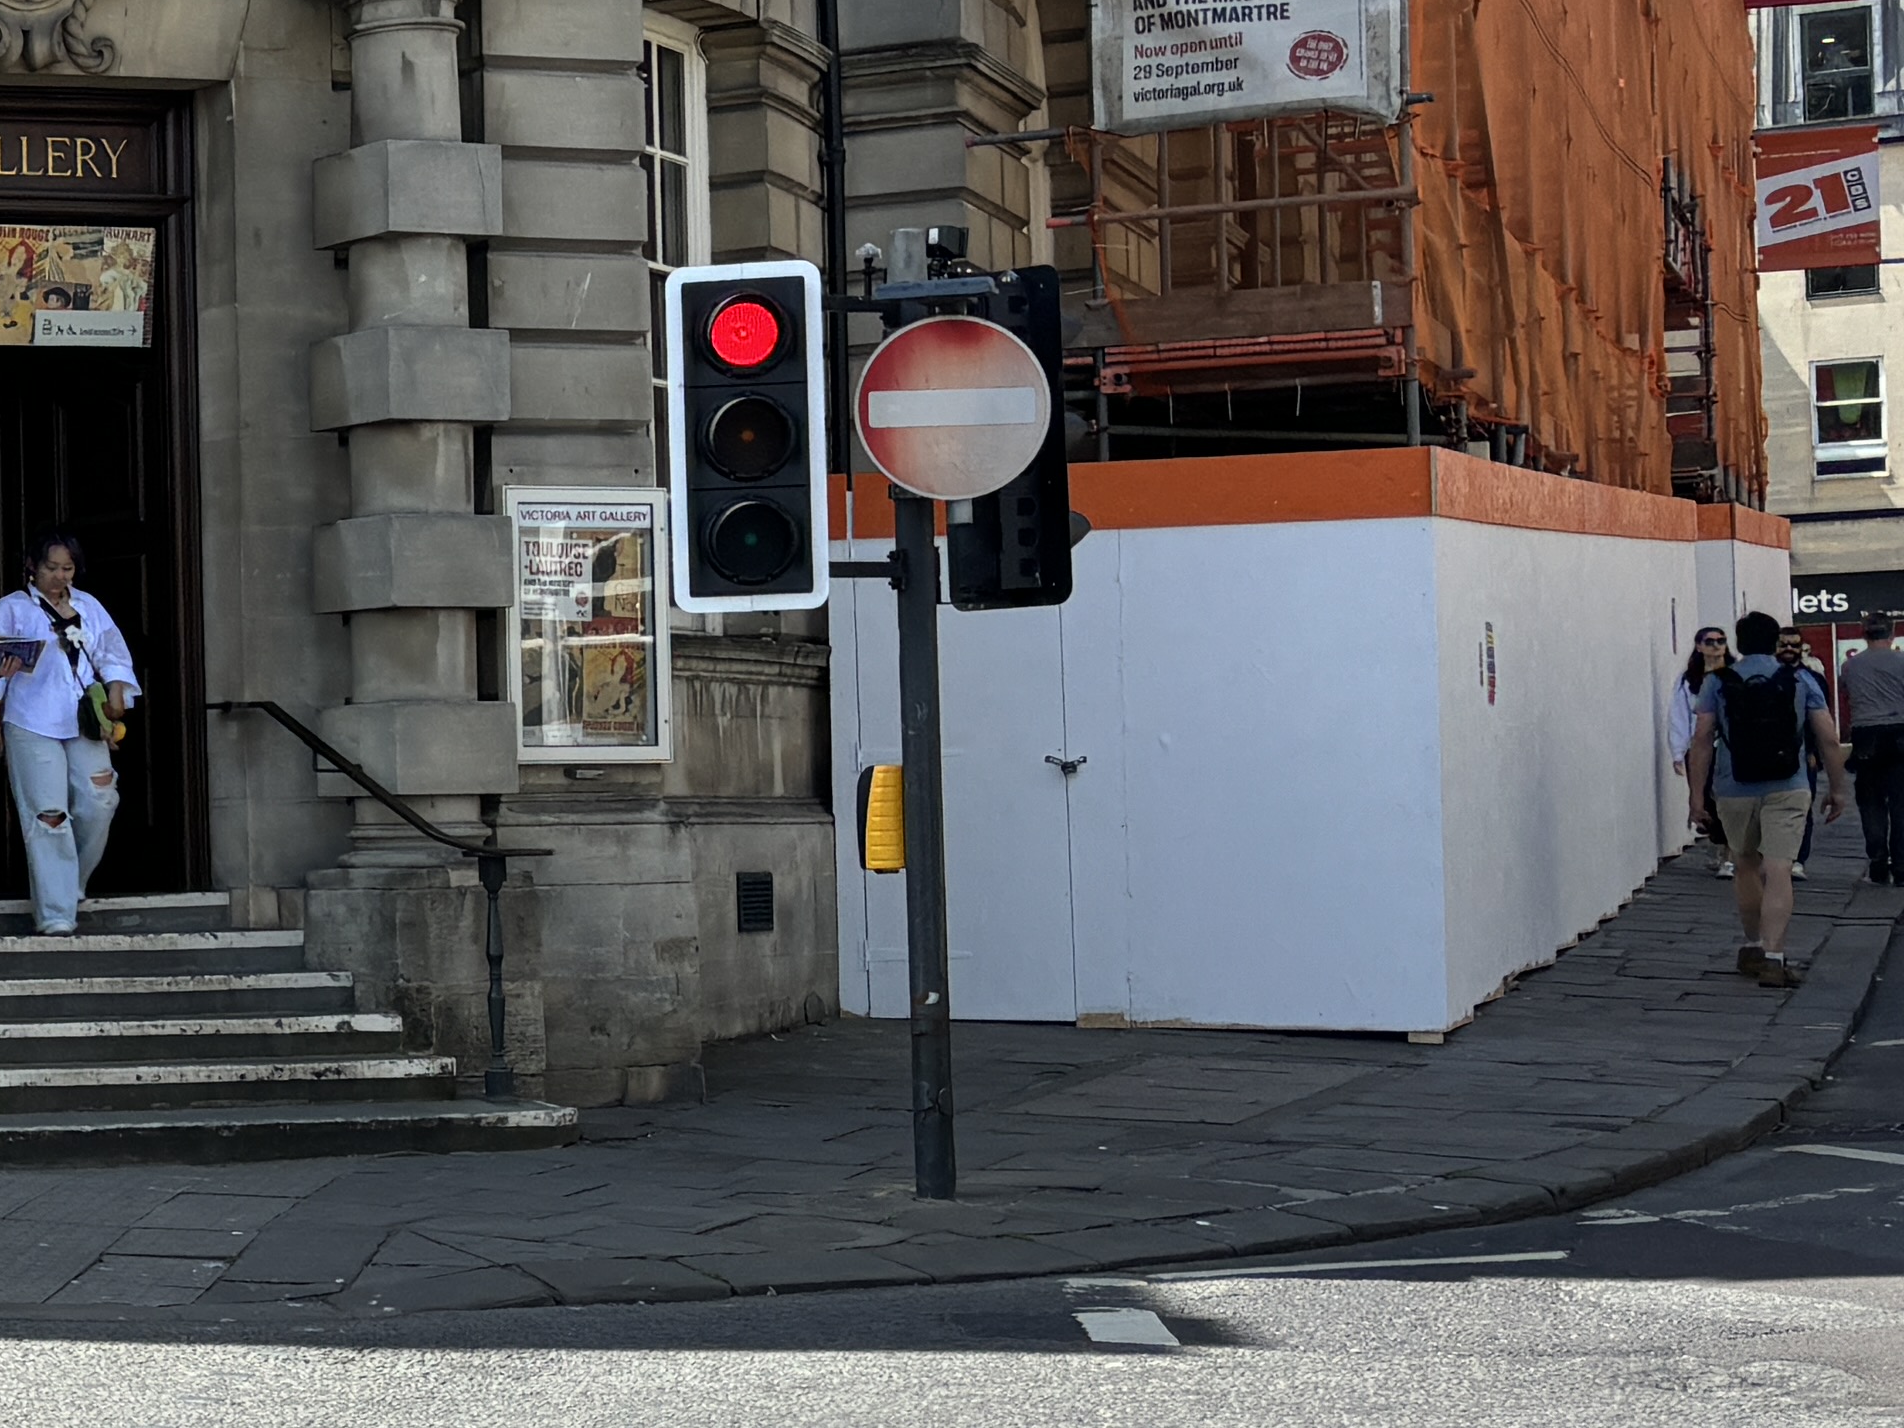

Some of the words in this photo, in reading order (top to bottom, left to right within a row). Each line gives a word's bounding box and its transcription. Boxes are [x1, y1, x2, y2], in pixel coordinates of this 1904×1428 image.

[1134, 13, 1156, 35] OF
[1160, 2, 1291, 31] MONTMARTRE
[1133, 43, 1172, 60] Now
[1173, 39, 1208, 59] open
[1209, 32, 1243, 51] until
[1155, 56, 1239, 79] September
[1133, 76, 1245, 103] victoriagal.org.uk
[1764, 172, 1852, 229] 21
[520, 510, 571, 521] VICTORIA
[575, 510, 597, 522] ART
[599, 511, 648, 522] GALLERY
